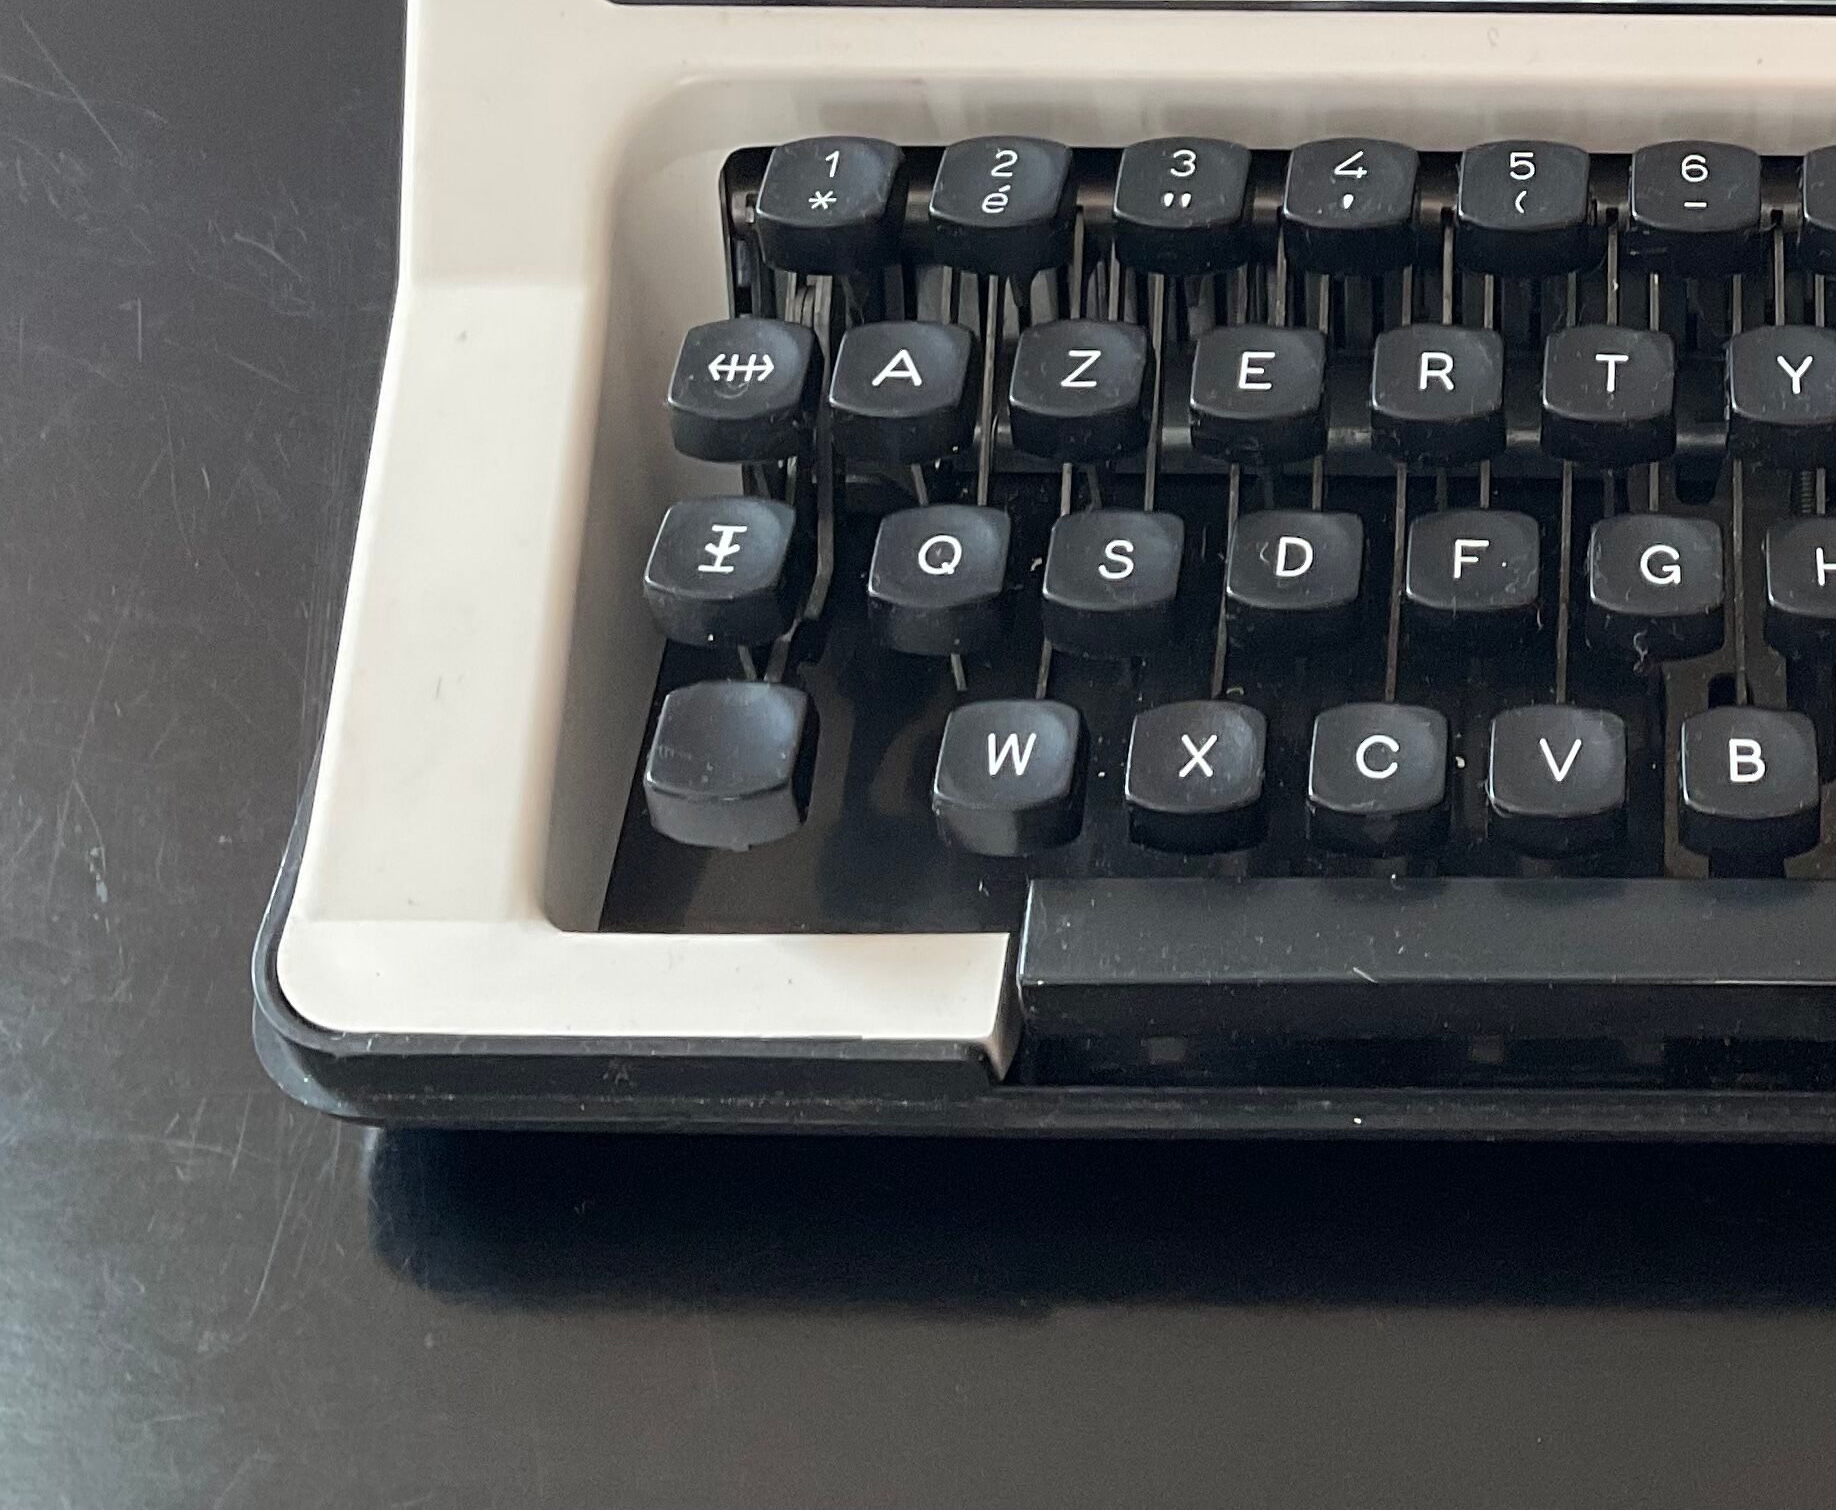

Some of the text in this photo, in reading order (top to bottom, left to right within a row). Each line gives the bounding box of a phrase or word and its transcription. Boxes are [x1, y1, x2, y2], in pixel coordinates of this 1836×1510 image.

[824, 150, 840, 178] 1
[990, 148, 1018, 178] 2
[1169, 149, 1197, 178] 3
[1333, 150, 1368, 179] 4
[1509, 151, 1536, 181] 5
[1681, 154, 1709, 183] 6
[981, 184, 1011, 214] é
[871, 348, 923, 387] A
[1060, 349, 1102, 388] Z
[1237, 351, 1276, 390] E
[1418, 351, 1455, 391] R
[1595, 353, 1629, 393] T
[1776, 355, 1813, 395] Y
[917, 534, 963, 575] Q
[1098, 539, 1134, 580] S
[1275, 536, 1314, 578] D
[1453, 538, 1490, 579] F
[1639, 544, 1681, 585] G
[987, 732, 1037, 776] W
[1178, 734, 1218, 778] X
[1355, 734, 1400, 780] C
[1539, 737, 1582, 782] V
[1728, 738, 1766, 783] B
